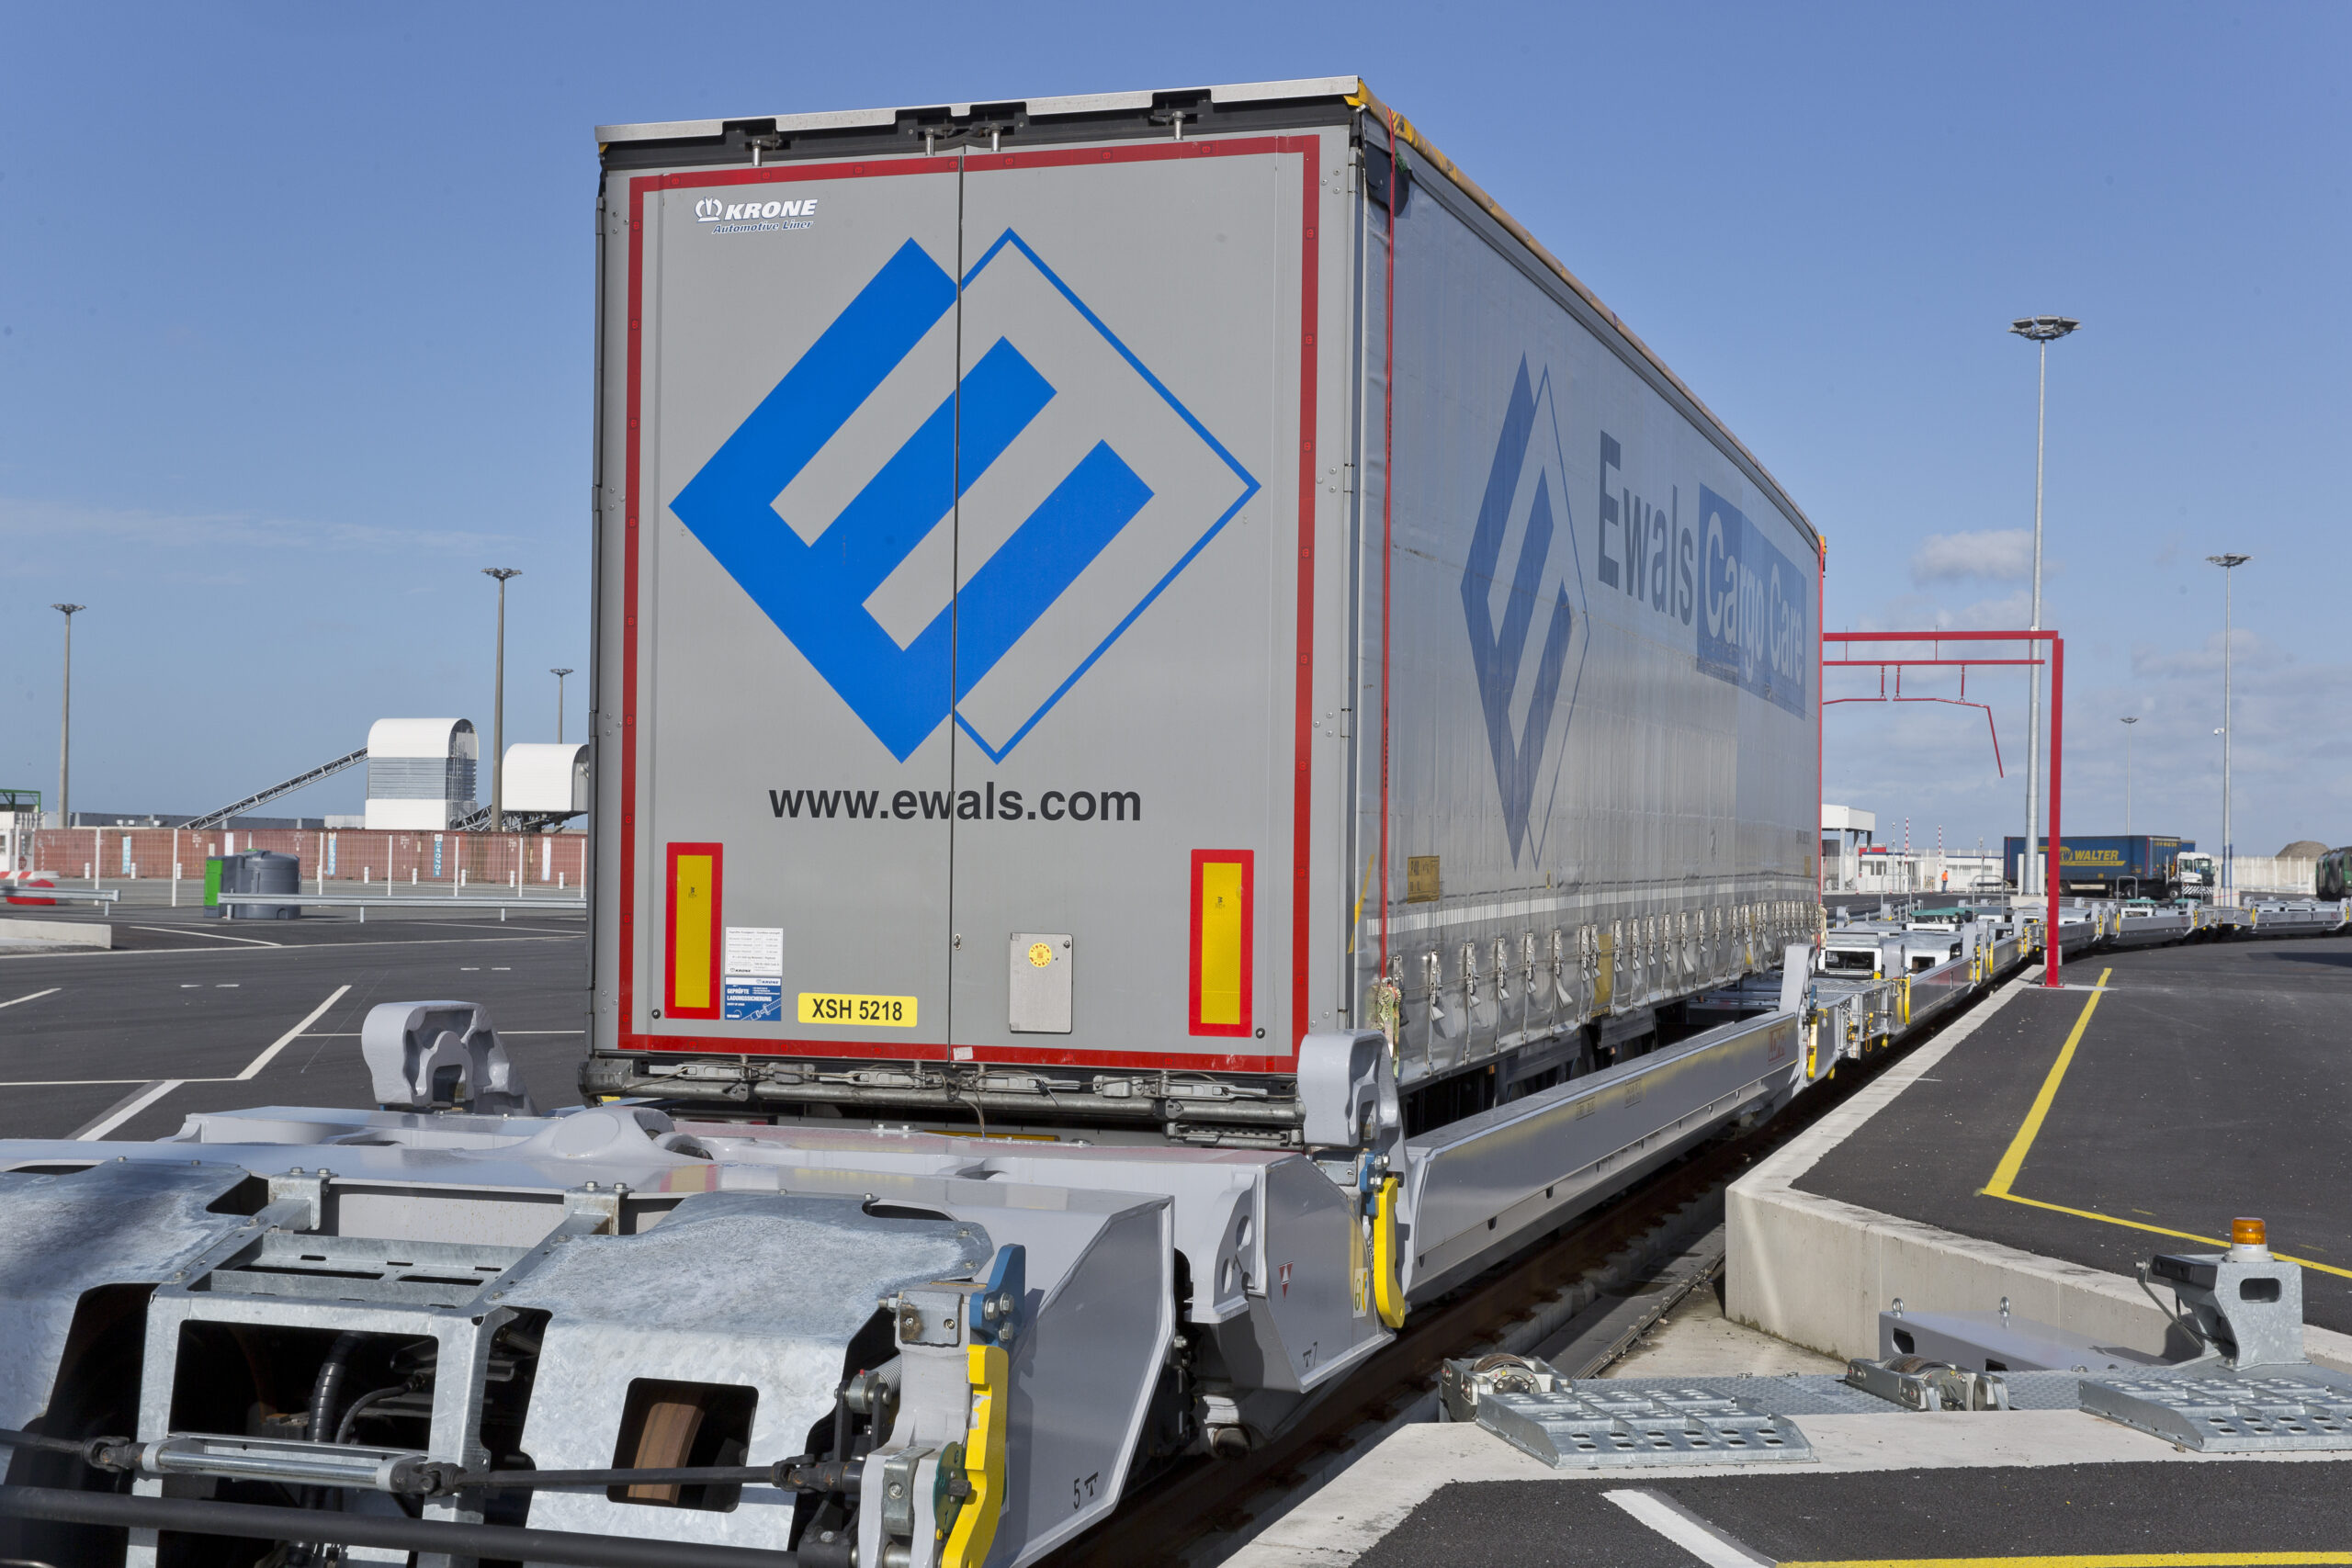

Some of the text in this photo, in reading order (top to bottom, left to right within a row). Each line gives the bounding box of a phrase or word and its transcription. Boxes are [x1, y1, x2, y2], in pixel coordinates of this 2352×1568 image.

[724, 199, 818, 221] KRONE
[712, 220, 814, 234] Automotive Liner
[1598, 429, 1803, 687] Ewals Cargo Care
[768, 782, 1141, 822] www.ewals.com
[2075, 850, 2119, 861] WALTER
[812, 998, 903, 1021] XSH 5218
[1073, 1477, 1080, 1510] 5
